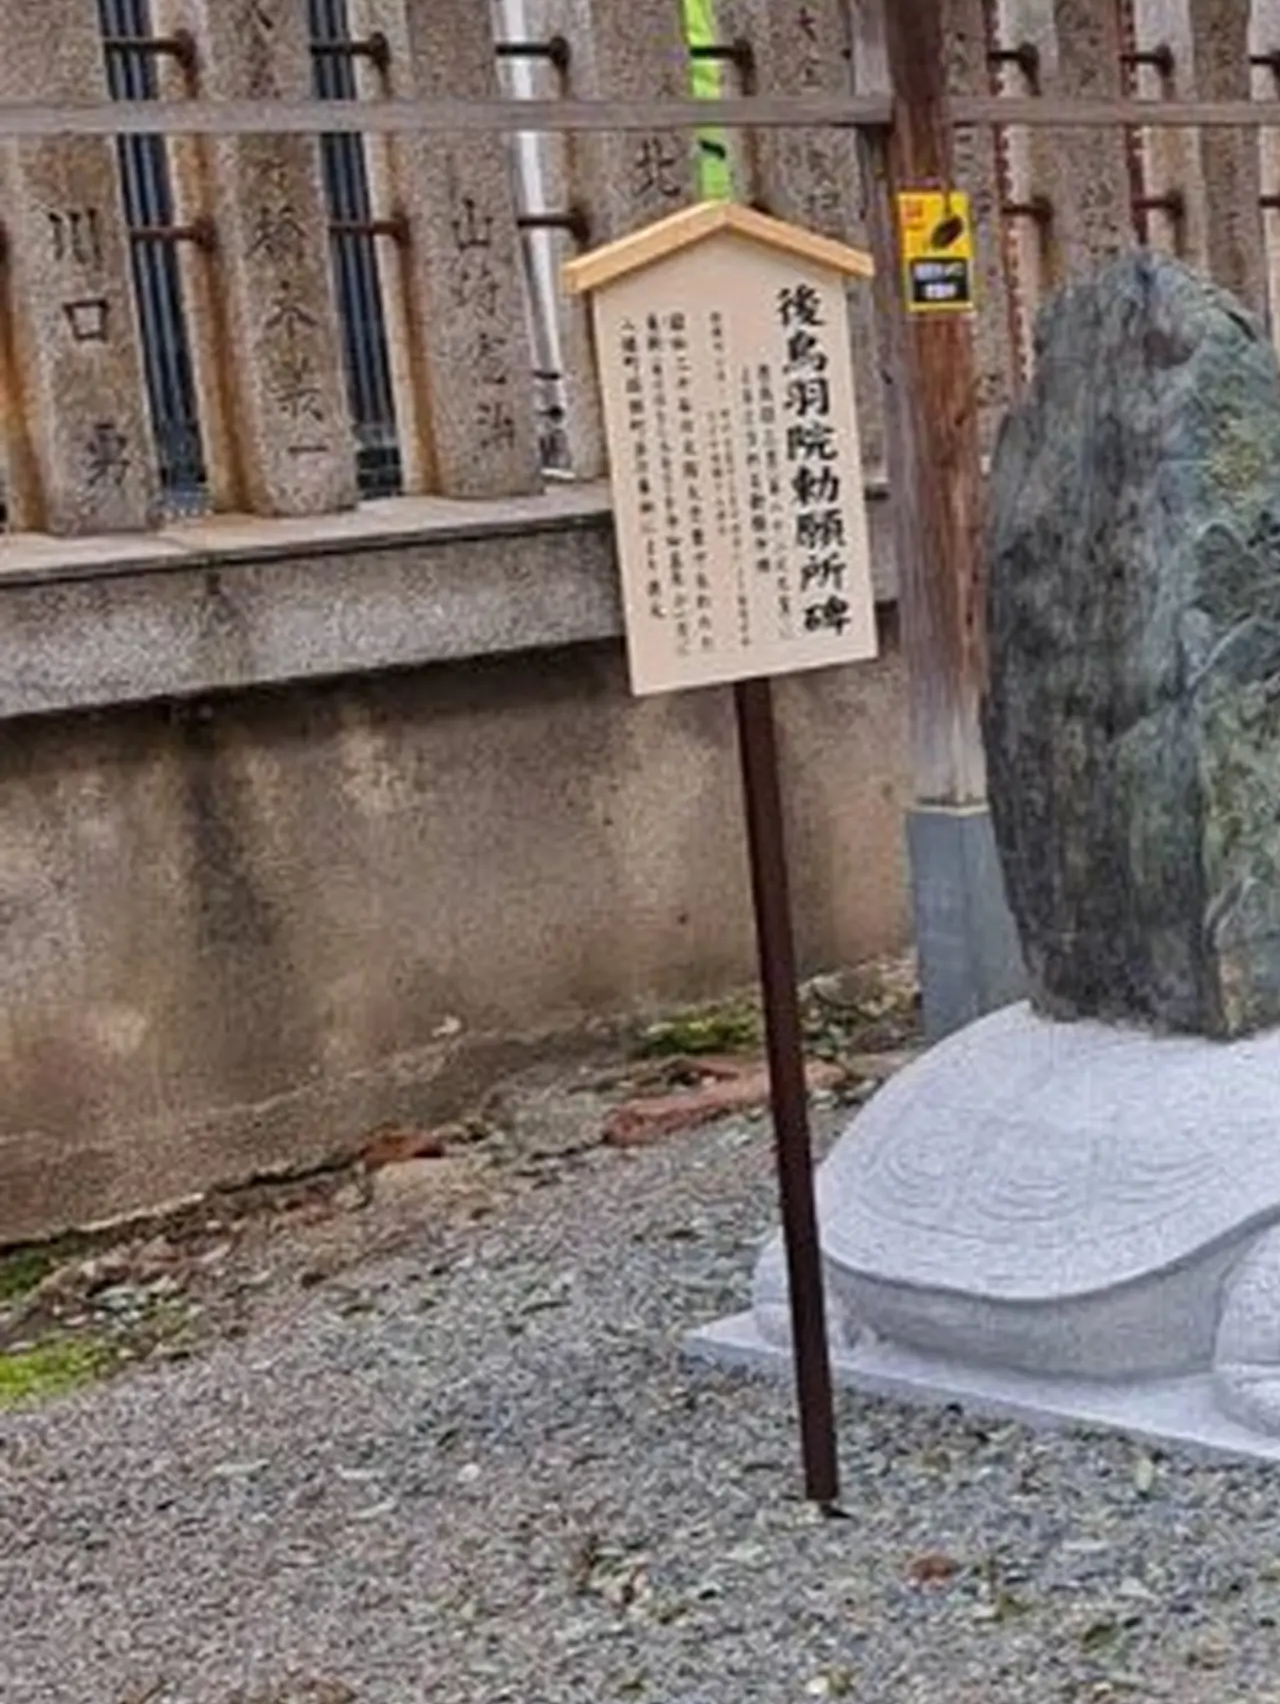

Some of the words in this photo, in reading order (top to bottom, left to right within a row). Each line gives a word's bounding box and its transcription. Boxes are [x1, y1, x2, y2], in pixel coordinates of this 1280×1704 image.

[774, 282, 852, 638] 後鳥羽院勅願所碑
